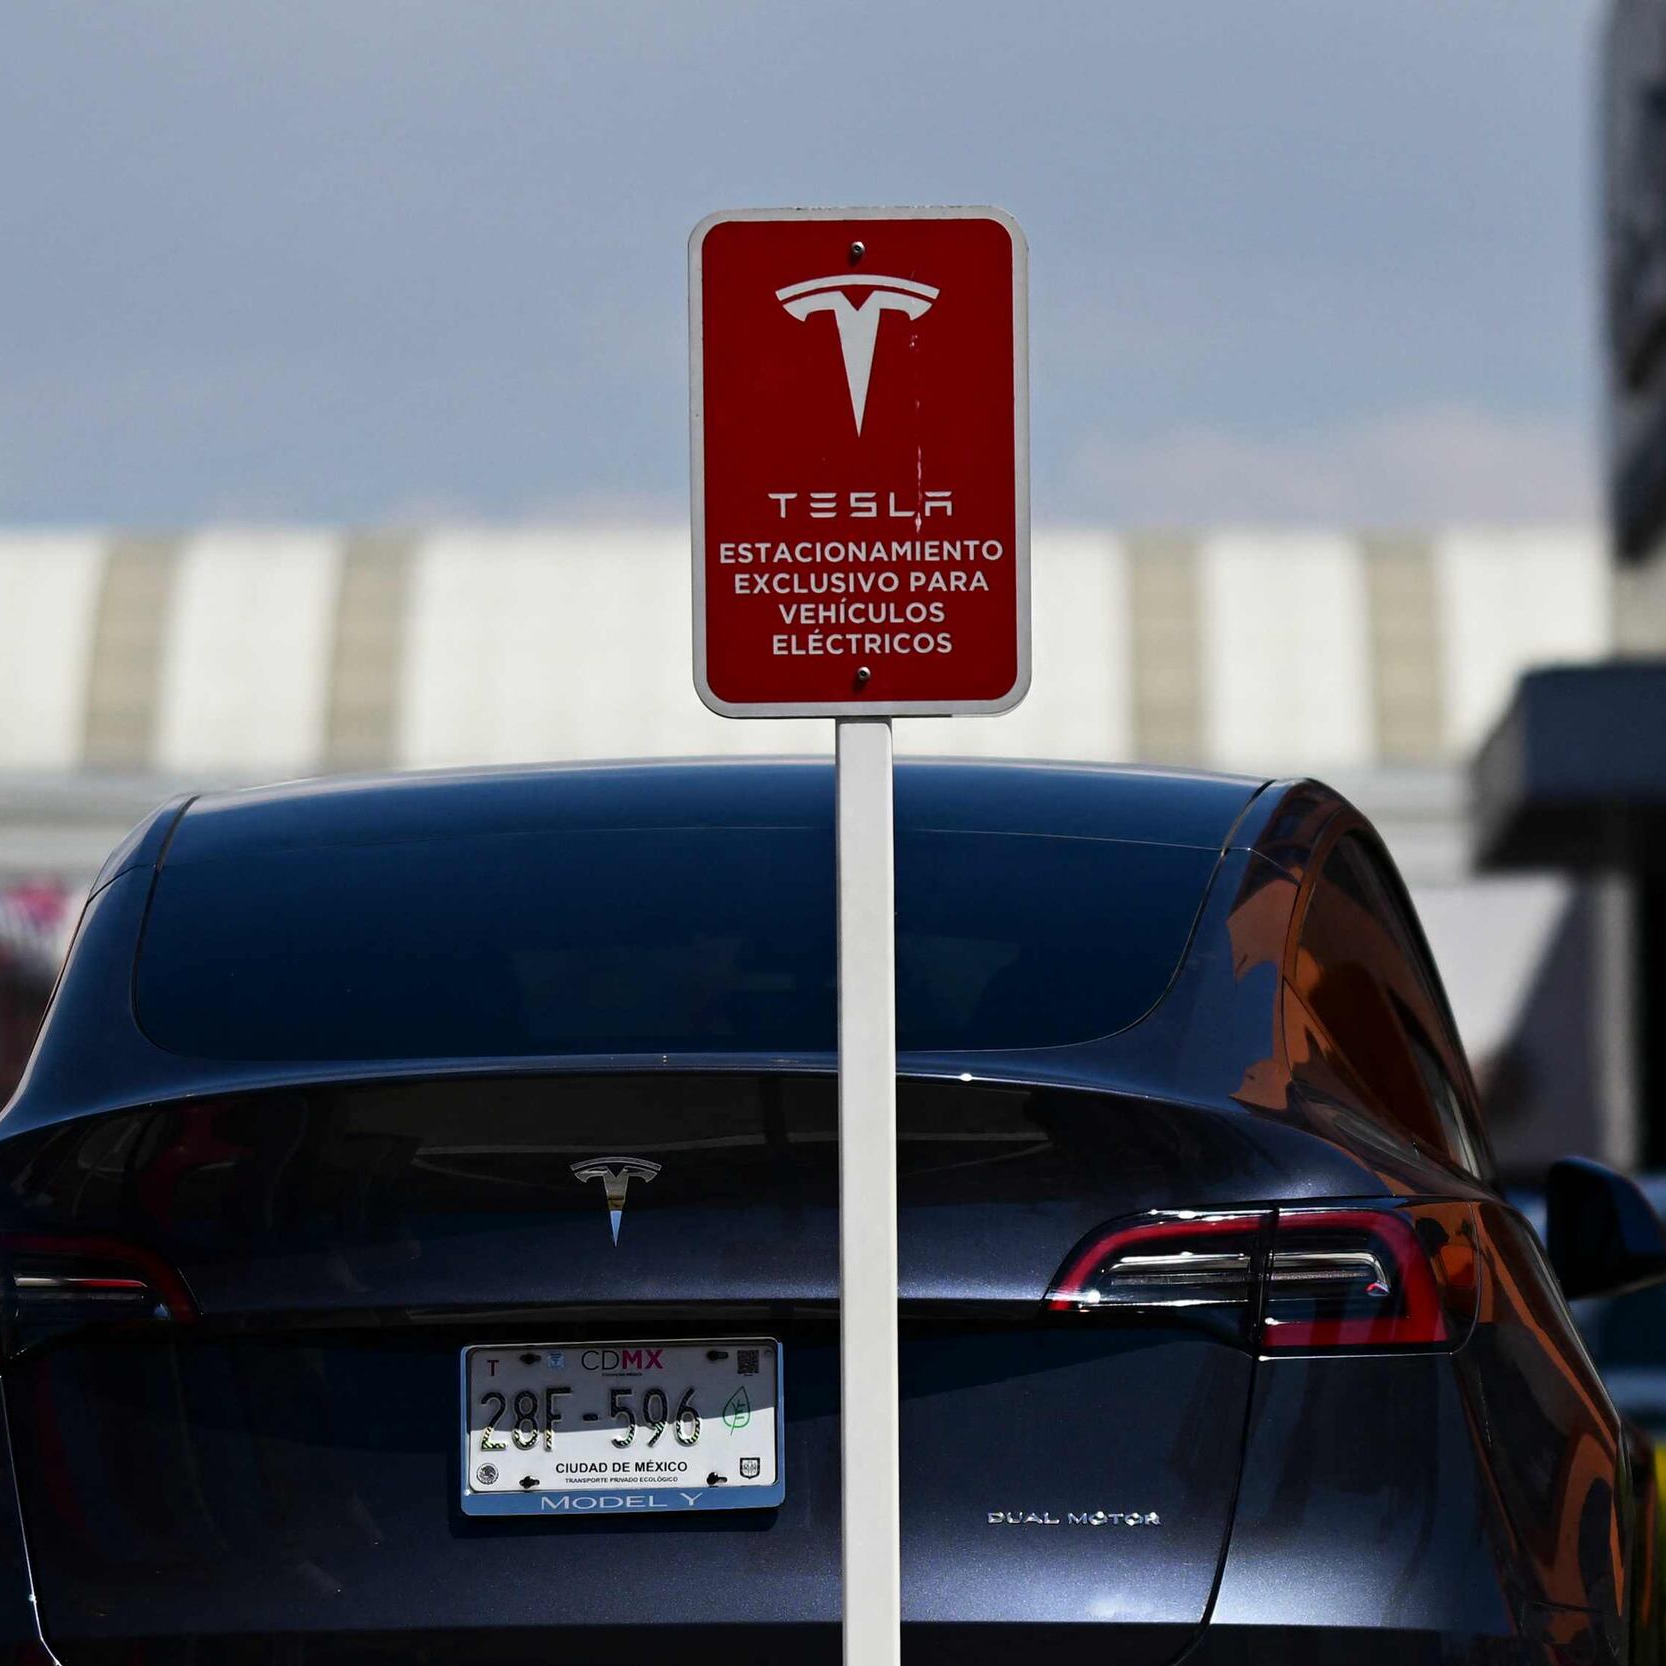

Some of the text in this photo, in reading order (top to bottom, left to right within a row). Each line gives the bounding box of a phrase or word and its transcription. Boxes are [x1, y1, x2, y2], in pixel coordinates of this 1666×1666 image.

[768, 491, 953, 518] TESLA
[719, 540, 1004, 564] ESTACIONAMIENTO
[734, 570, 989, 595] EXCLUSIVO PARA
[778, 597, 946, 624] VEHÍCULOS
[772, 628, 953, 656] ELÉCTRICOS
[487, 1359, 499, 1377] T
[581, 1349, 664, 1371] CDMX
[555, 1459, 688, 1474] CIUDAD DE MÉXICO
[639, 1475, 679, 1483] ECOLÓGICO
[541, 1492, 703, 1511] MODEL Y
[987, 1511, 1162, 1526] DUAL MOTOR
